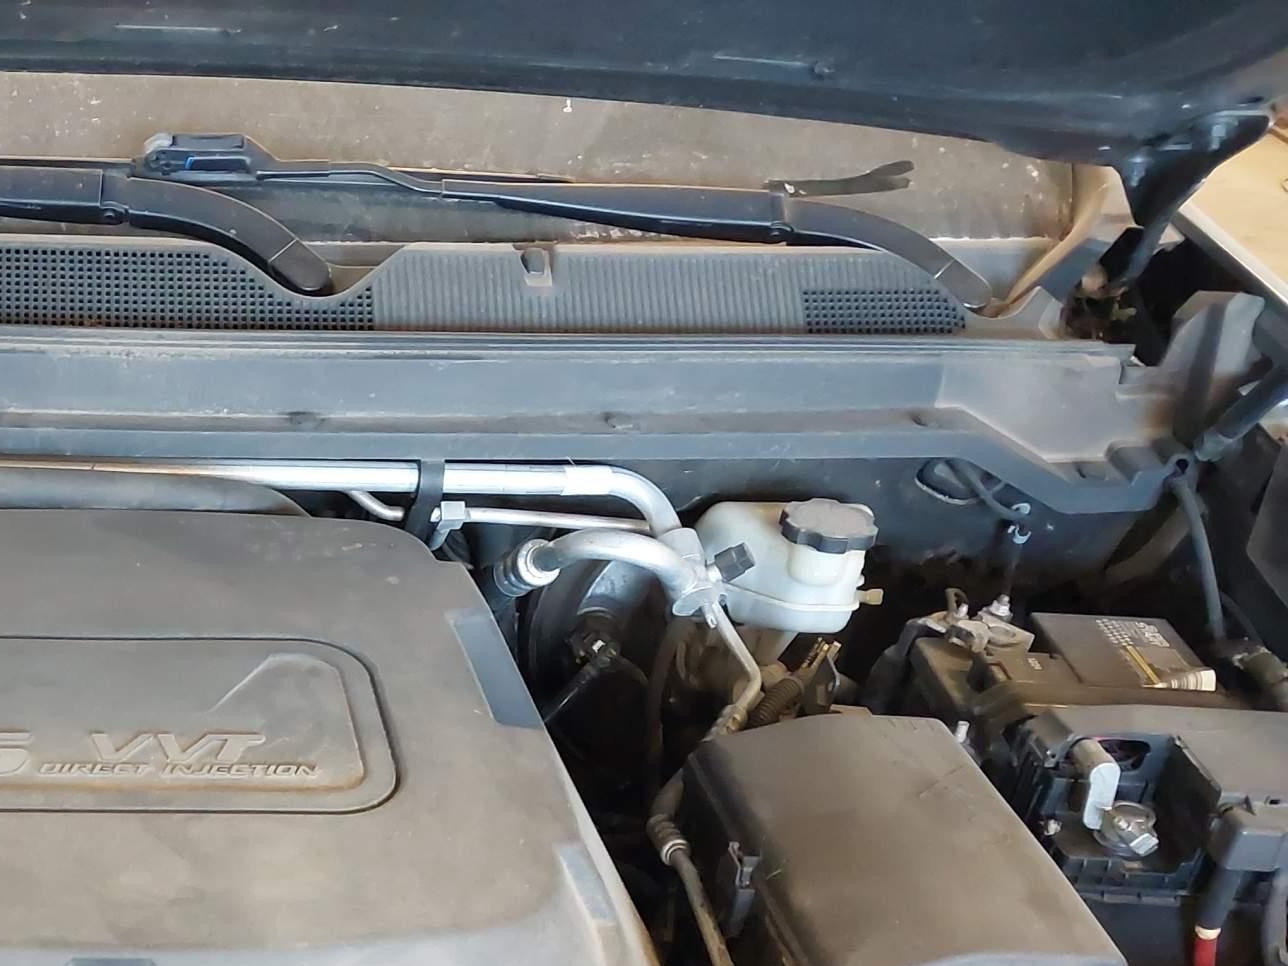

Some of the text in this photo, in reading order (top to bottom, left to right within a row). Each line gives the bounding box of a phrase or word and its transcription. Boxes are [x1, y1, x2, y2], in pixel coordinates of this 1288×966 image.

[90, 731, 265, 763] VVT
[38, 762, 323, 778] DIRECT INJECTION
